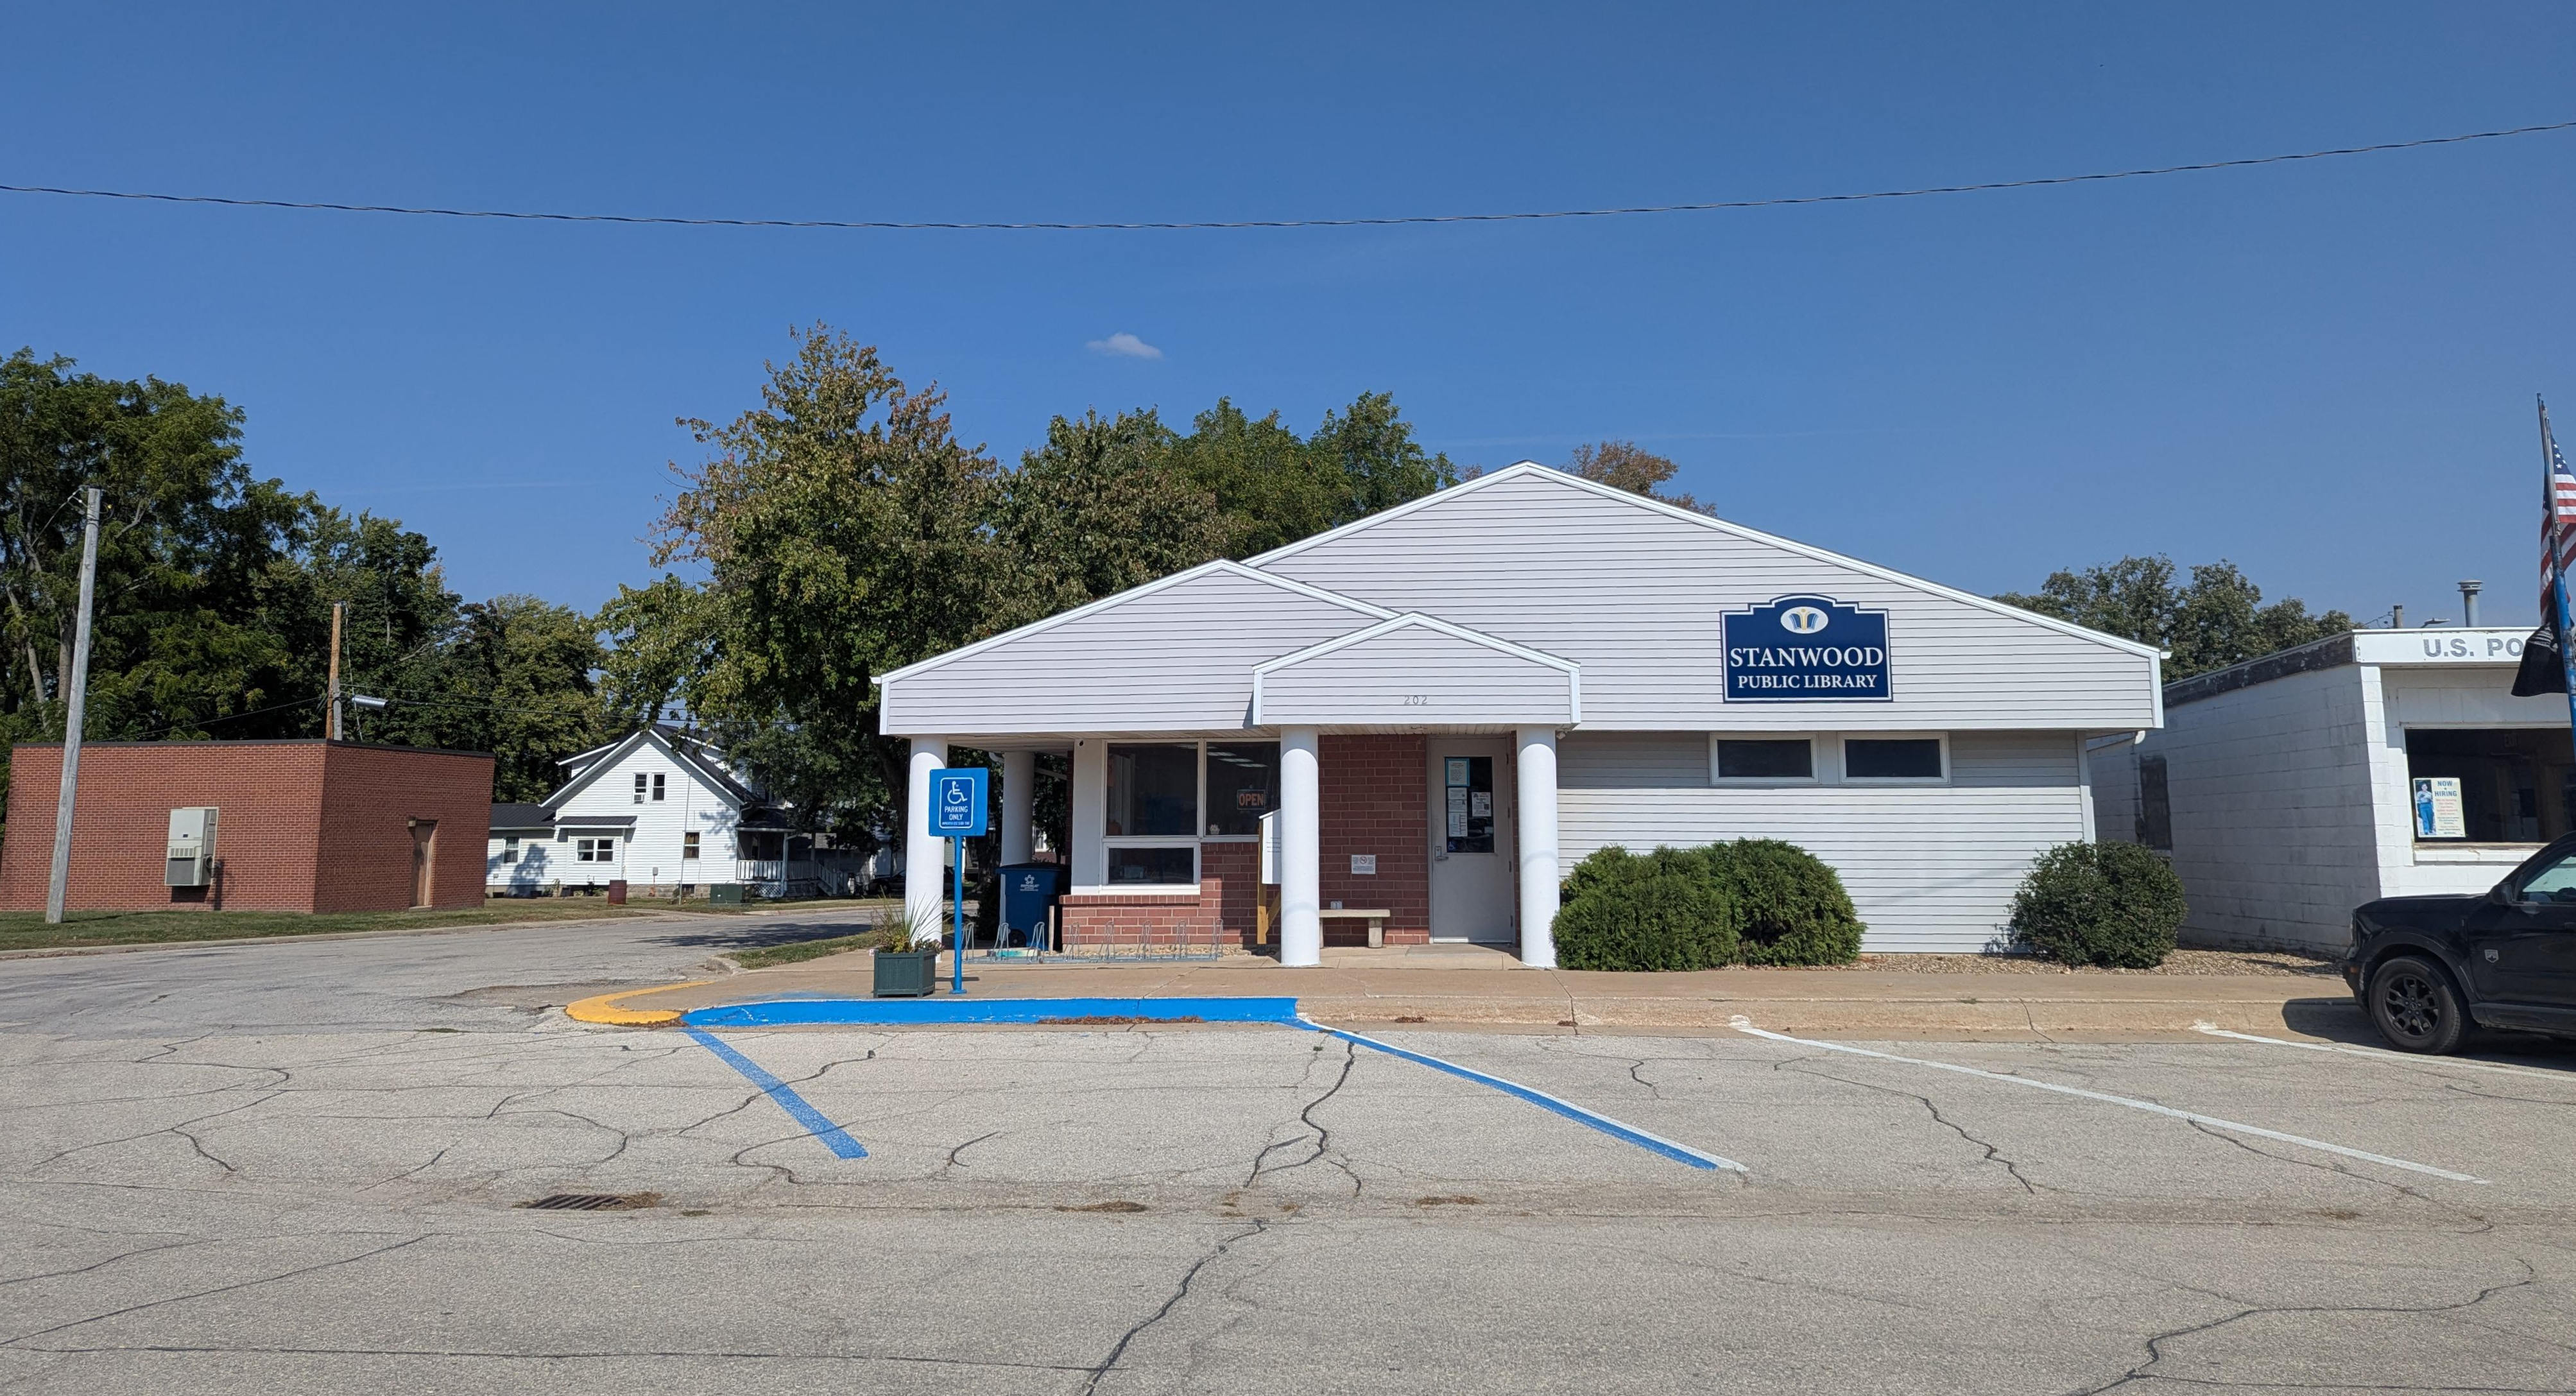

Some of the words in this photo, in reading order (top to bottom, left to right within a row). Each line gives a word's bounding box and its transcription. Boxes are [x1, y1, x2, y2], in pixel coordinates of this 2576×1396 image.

[2423, 638, 2474, 657] U.S.
[1730, 646, 1884, 667] STANWOOD
[1738, 675, 1799, 689] PUBLIC
[1803, 675, 1878, 689] LIBRARY
[1404, 695, 1428, 705] 202
[1239, 793, 1264, 806] OPEN
